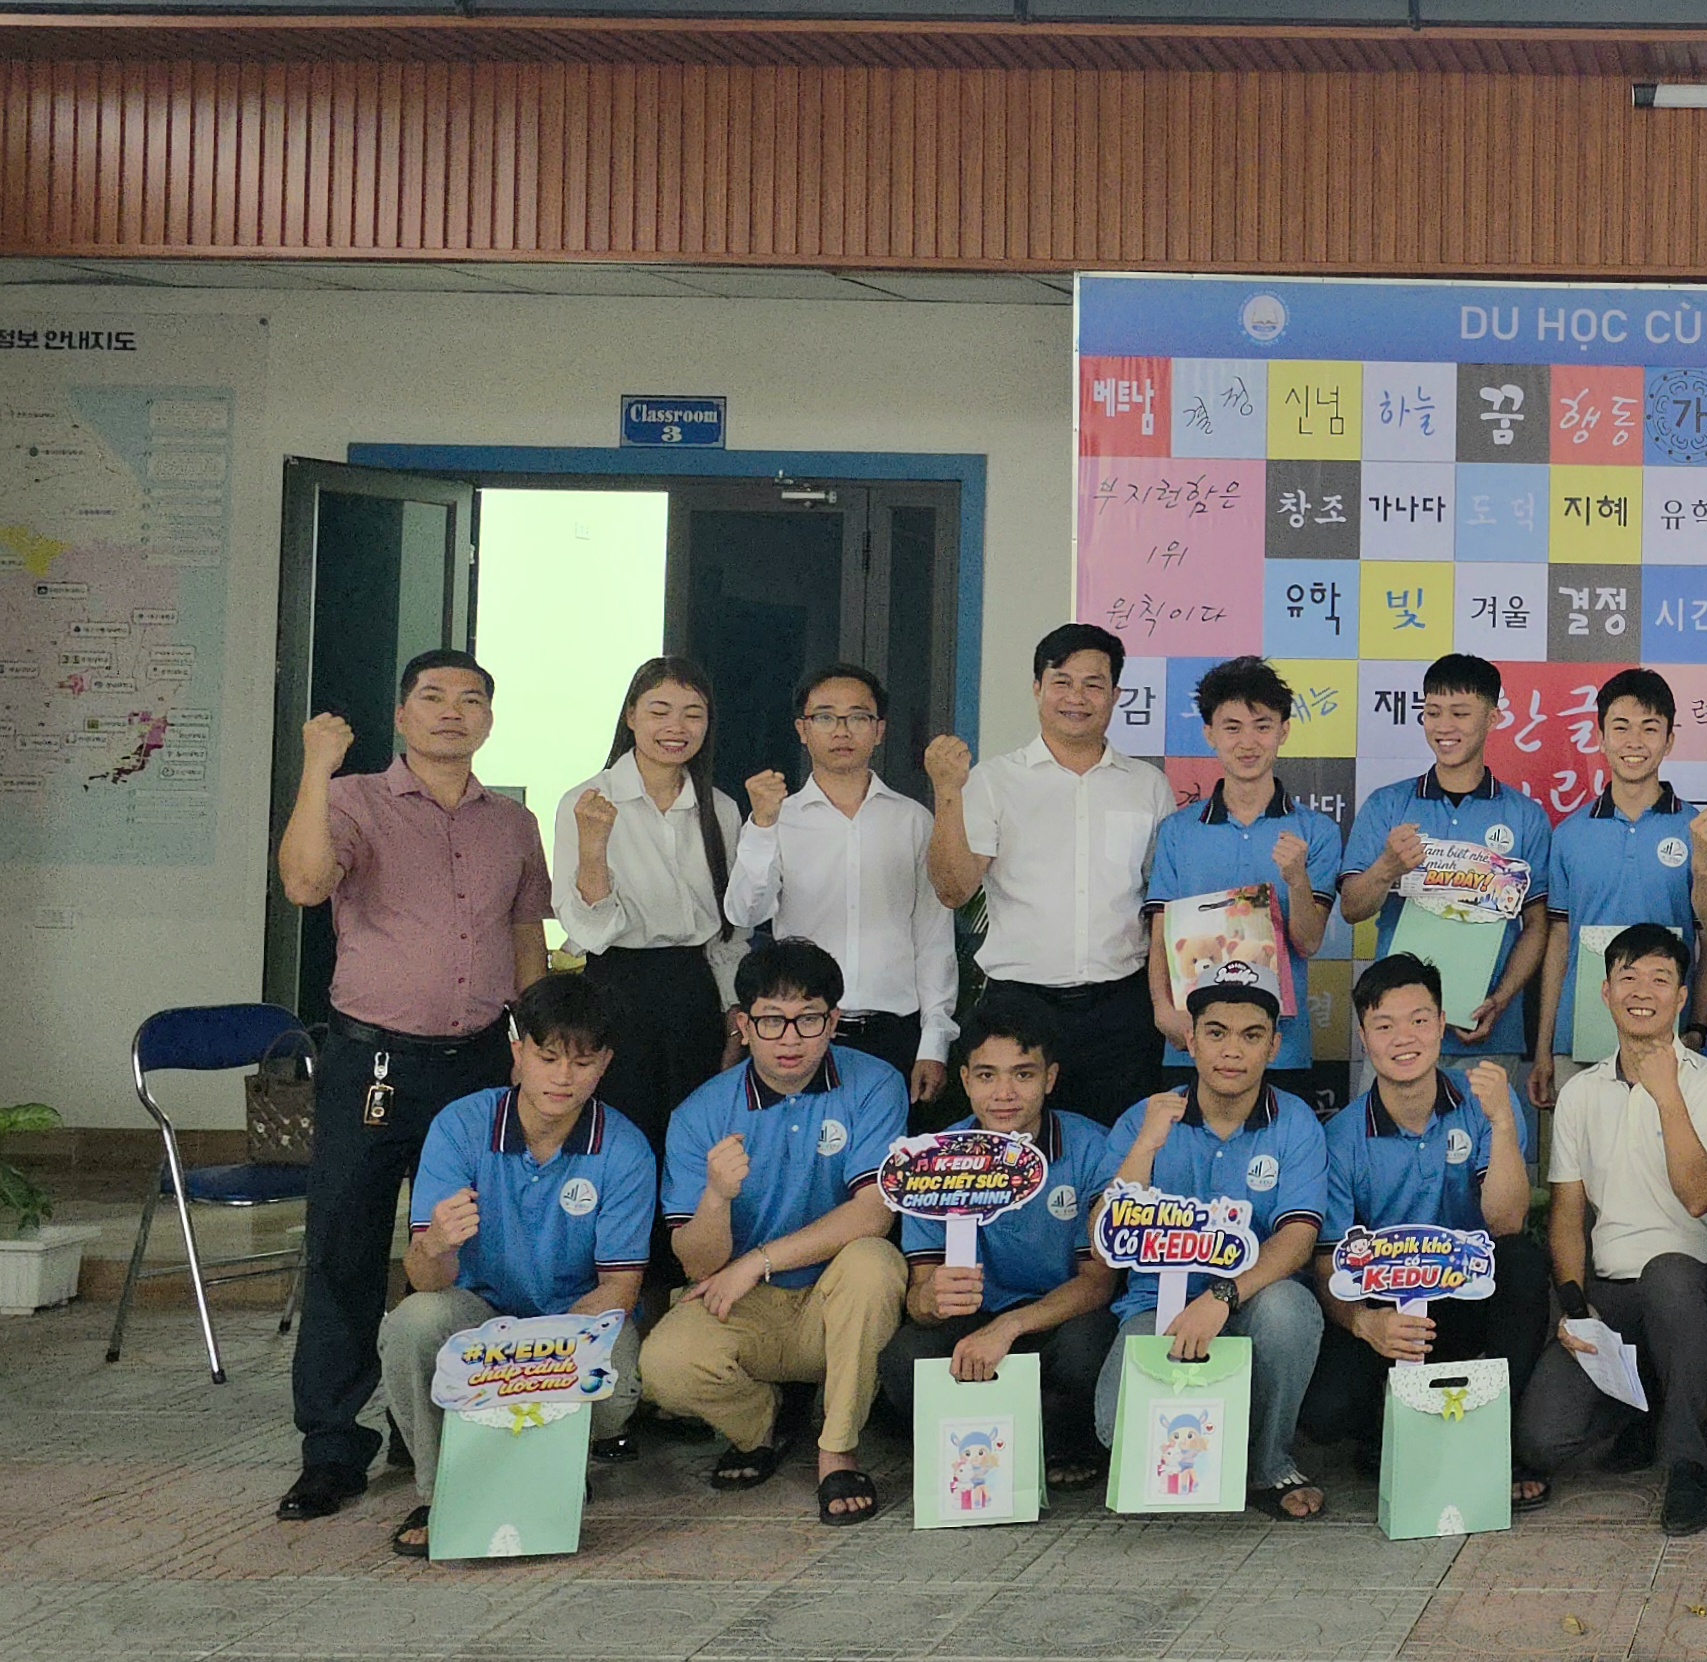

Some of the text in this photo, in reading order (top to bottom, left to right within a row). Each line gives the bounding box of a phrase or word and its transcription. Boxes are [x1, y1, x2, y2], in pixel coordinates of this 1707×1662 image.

[1460, 305, 1519, 341] DU
[1537, 307, 1628, 351] HỌC
[630, 403, 718, 423] Classroom
[1093, 378, 1154, 436] 베트남
[1284, 385, 1345, 435] 신념
[1379, 386, 1436, 436] 하늘
[1479, 384, 1525, 445] 꿈
[1559, 388, 1638, 447] 행동
[661, 425, 682, 442] 3
[1277, 489, 1347, 529] 창조
[1368, 495, 1447, 523] 가나다
[1563, 495, 1629, 528] 지혜
[1286, 582, 1342, 636] 유학
[1386, 587, 1426, 630] 빛
[1470, 595, 1531, 629] 겨울
[1558, 586, 1627, 636] 결정
[1423, 869, 1455, 886] BAY
[934, 1156, 987, 1171] K-EDU
[905, 1170, 1010, 1193] HỌC HẾT SỨC
[901, 1189, 1013, 1208] CHƠI HẾT MÌNH
[1111, 1199, 1156, 1228] Visa
[1155, 1200, 1195, 1228] Khó
[1113, 1228, 1139, 1256] Có
[1139, 1229, 1216, 1263] K-EDU
[1371, 1236, 1420, 1259] Topik
[1420, 1235, 1453, 1255] khó
[1403, 1253, 1421, 1267] có
[1361, 1264, 1466, 1295] K-EDU lo
[461, 1336, 578, 1367] #K-EDU
